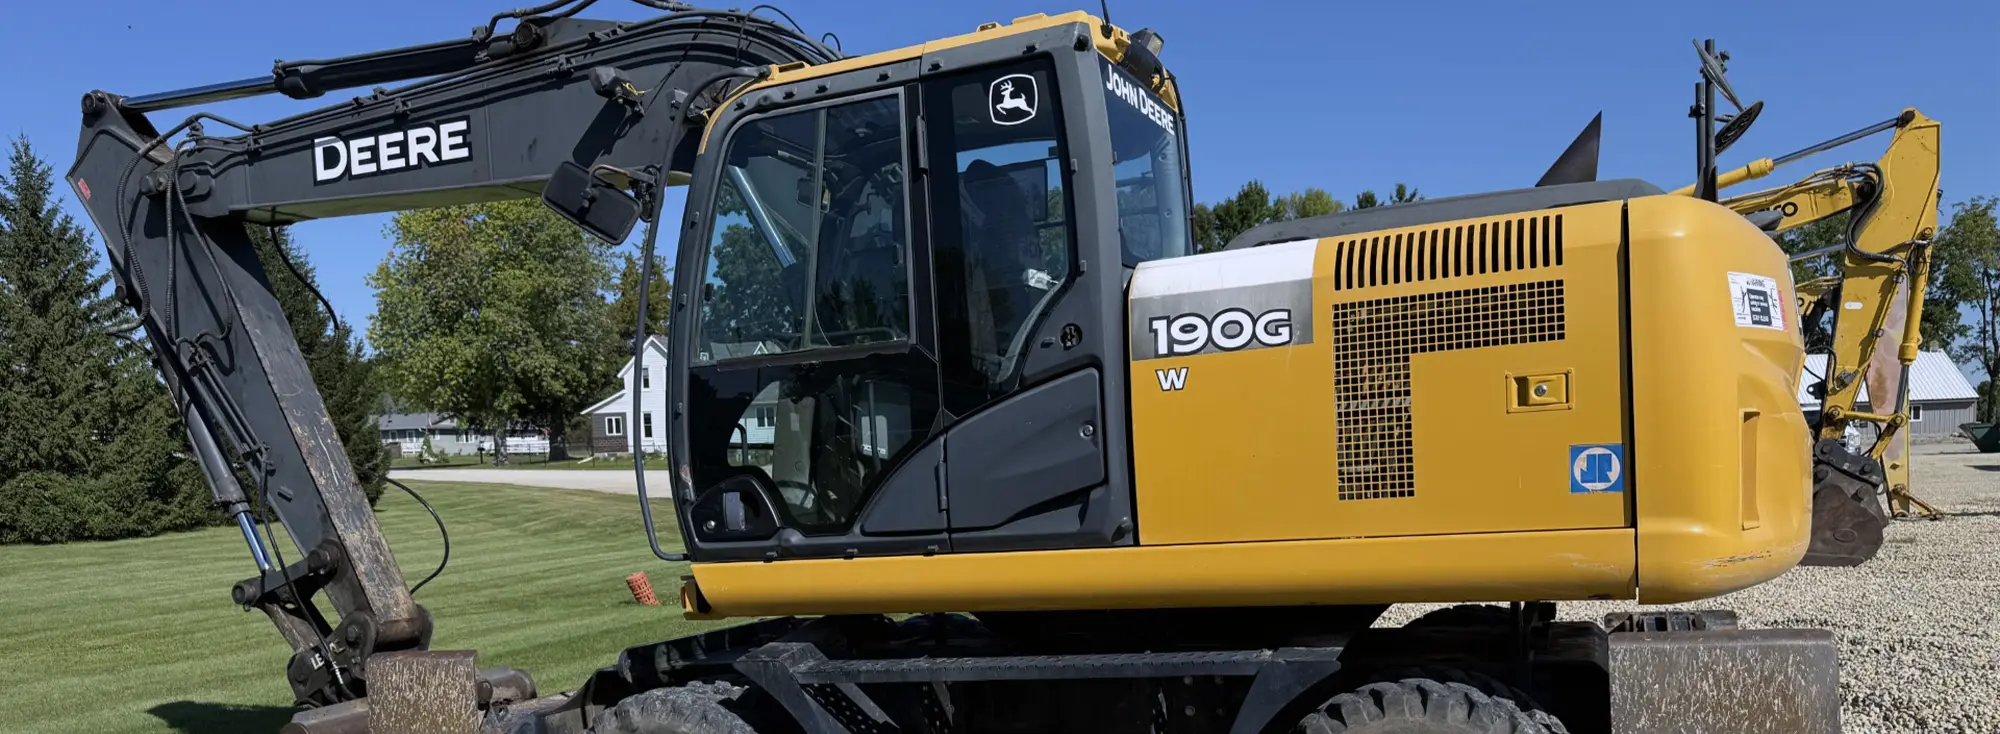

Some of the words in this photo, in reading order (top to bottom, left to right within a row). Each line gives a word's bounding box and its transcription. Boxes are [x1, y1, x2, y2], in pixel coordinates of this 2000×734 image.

[1106, 63, 1139, 110] JOHN
[1138, 86, 1175, 136] DEERE
[313, 119, 470, 182] DEERE
[1149, 307, 1293, 358] 190G
[1155, 366, 1190, 392] W
